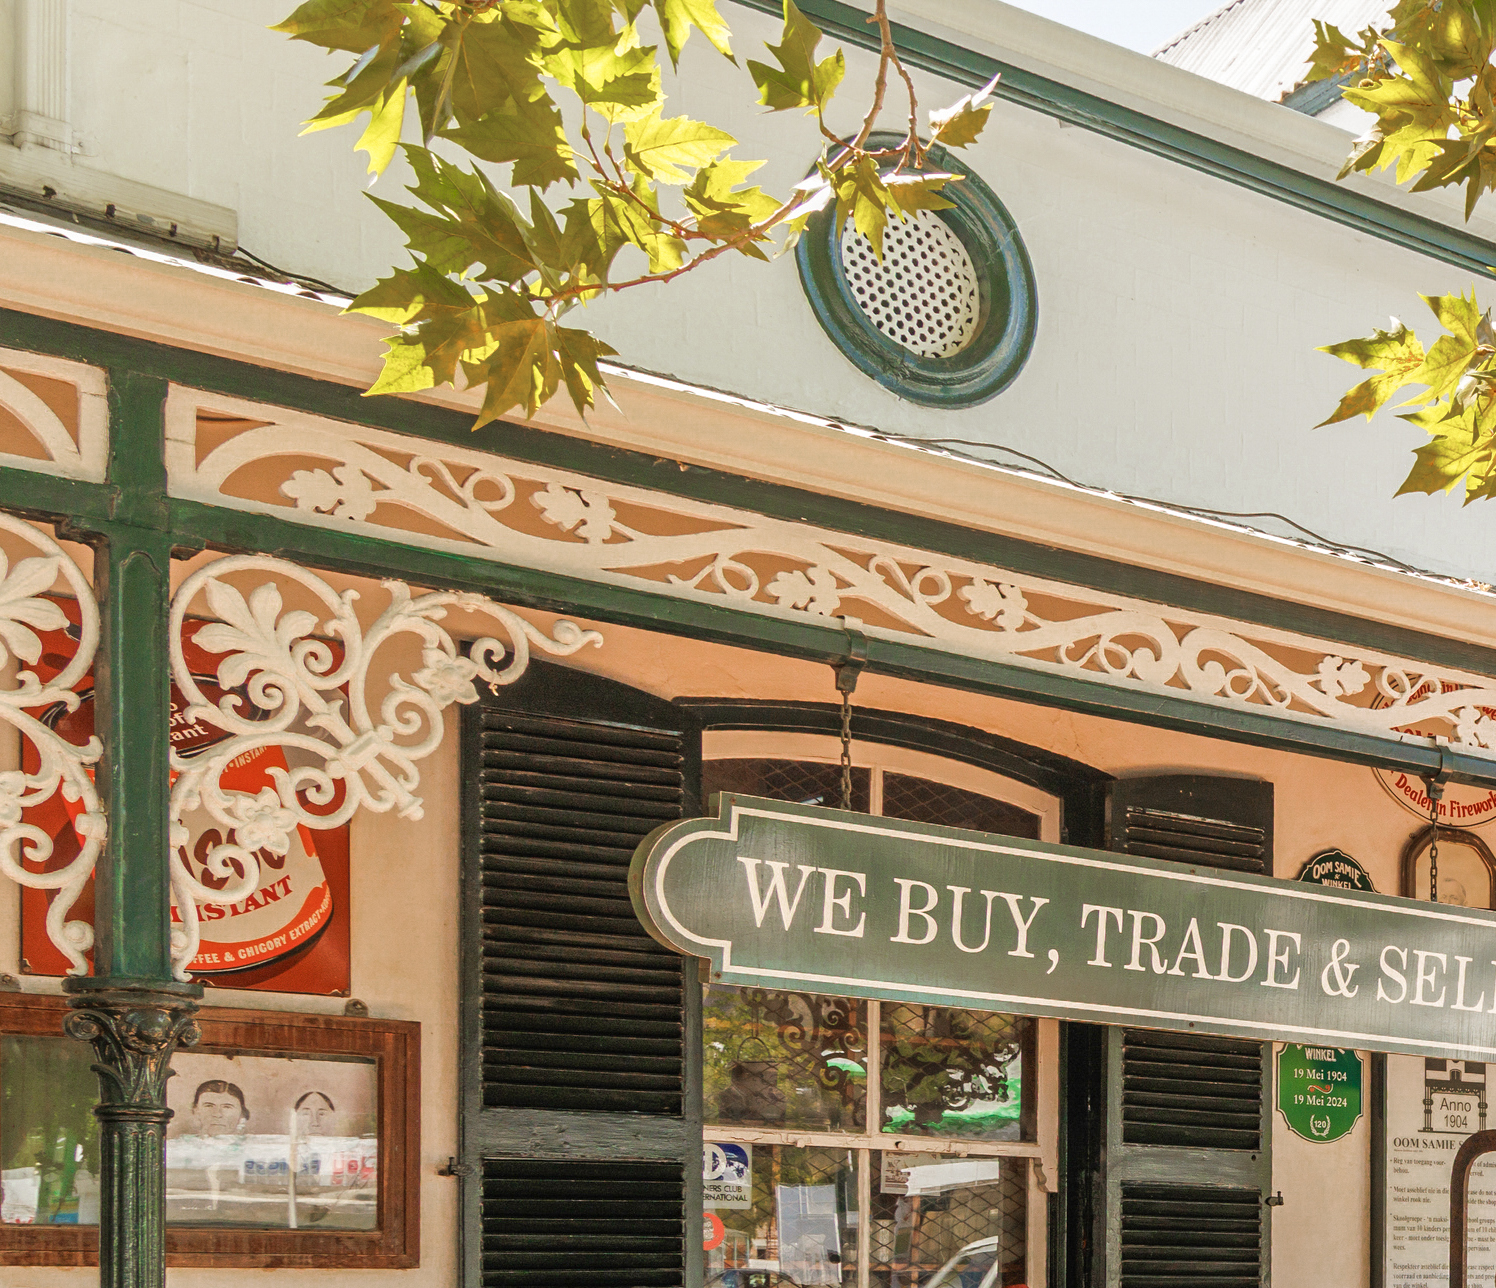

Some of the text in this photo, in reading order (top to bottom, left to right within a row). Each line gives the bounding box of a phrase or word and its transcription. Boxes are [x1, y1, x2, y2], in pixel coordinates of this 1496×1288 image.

[1436, 800, 1447, 815] in
[1313, 861, 1362, 888] OOM SAMIE
[737, 856, 867, 938] WE
[890, 878, 1060, 974] BUY,
[1080, 903, 1301, 990] TRADE
[1321, 938, 1360, 998] &
[224, 951, 235, 962] &
[238, 934, 287, 959] CHICORY
[289, 912, 321, 941] EXTRACT
[1304, 1047, 1337, 1062] WINKEL
[1294, 1068, 1347, 1081] 19 Mei 1904
[1294, 1094, 1347, 1107] 19 Mei 2024
[1440, 1098, 1472, 1112] Anno
[1314, 1120, 1327, 1128] 120
[1444, 1114, 1468, 1128] 1904
[1393, 1136, 1455, 1150] OOM SAMIE
[1393, 1157, 1403, 1165] Reg
[1413, 1158, 1432, 1166] toegang
[723, 1185, 742, 1193] CLUB
[1393, 1195, 1409, 1203] winkel
